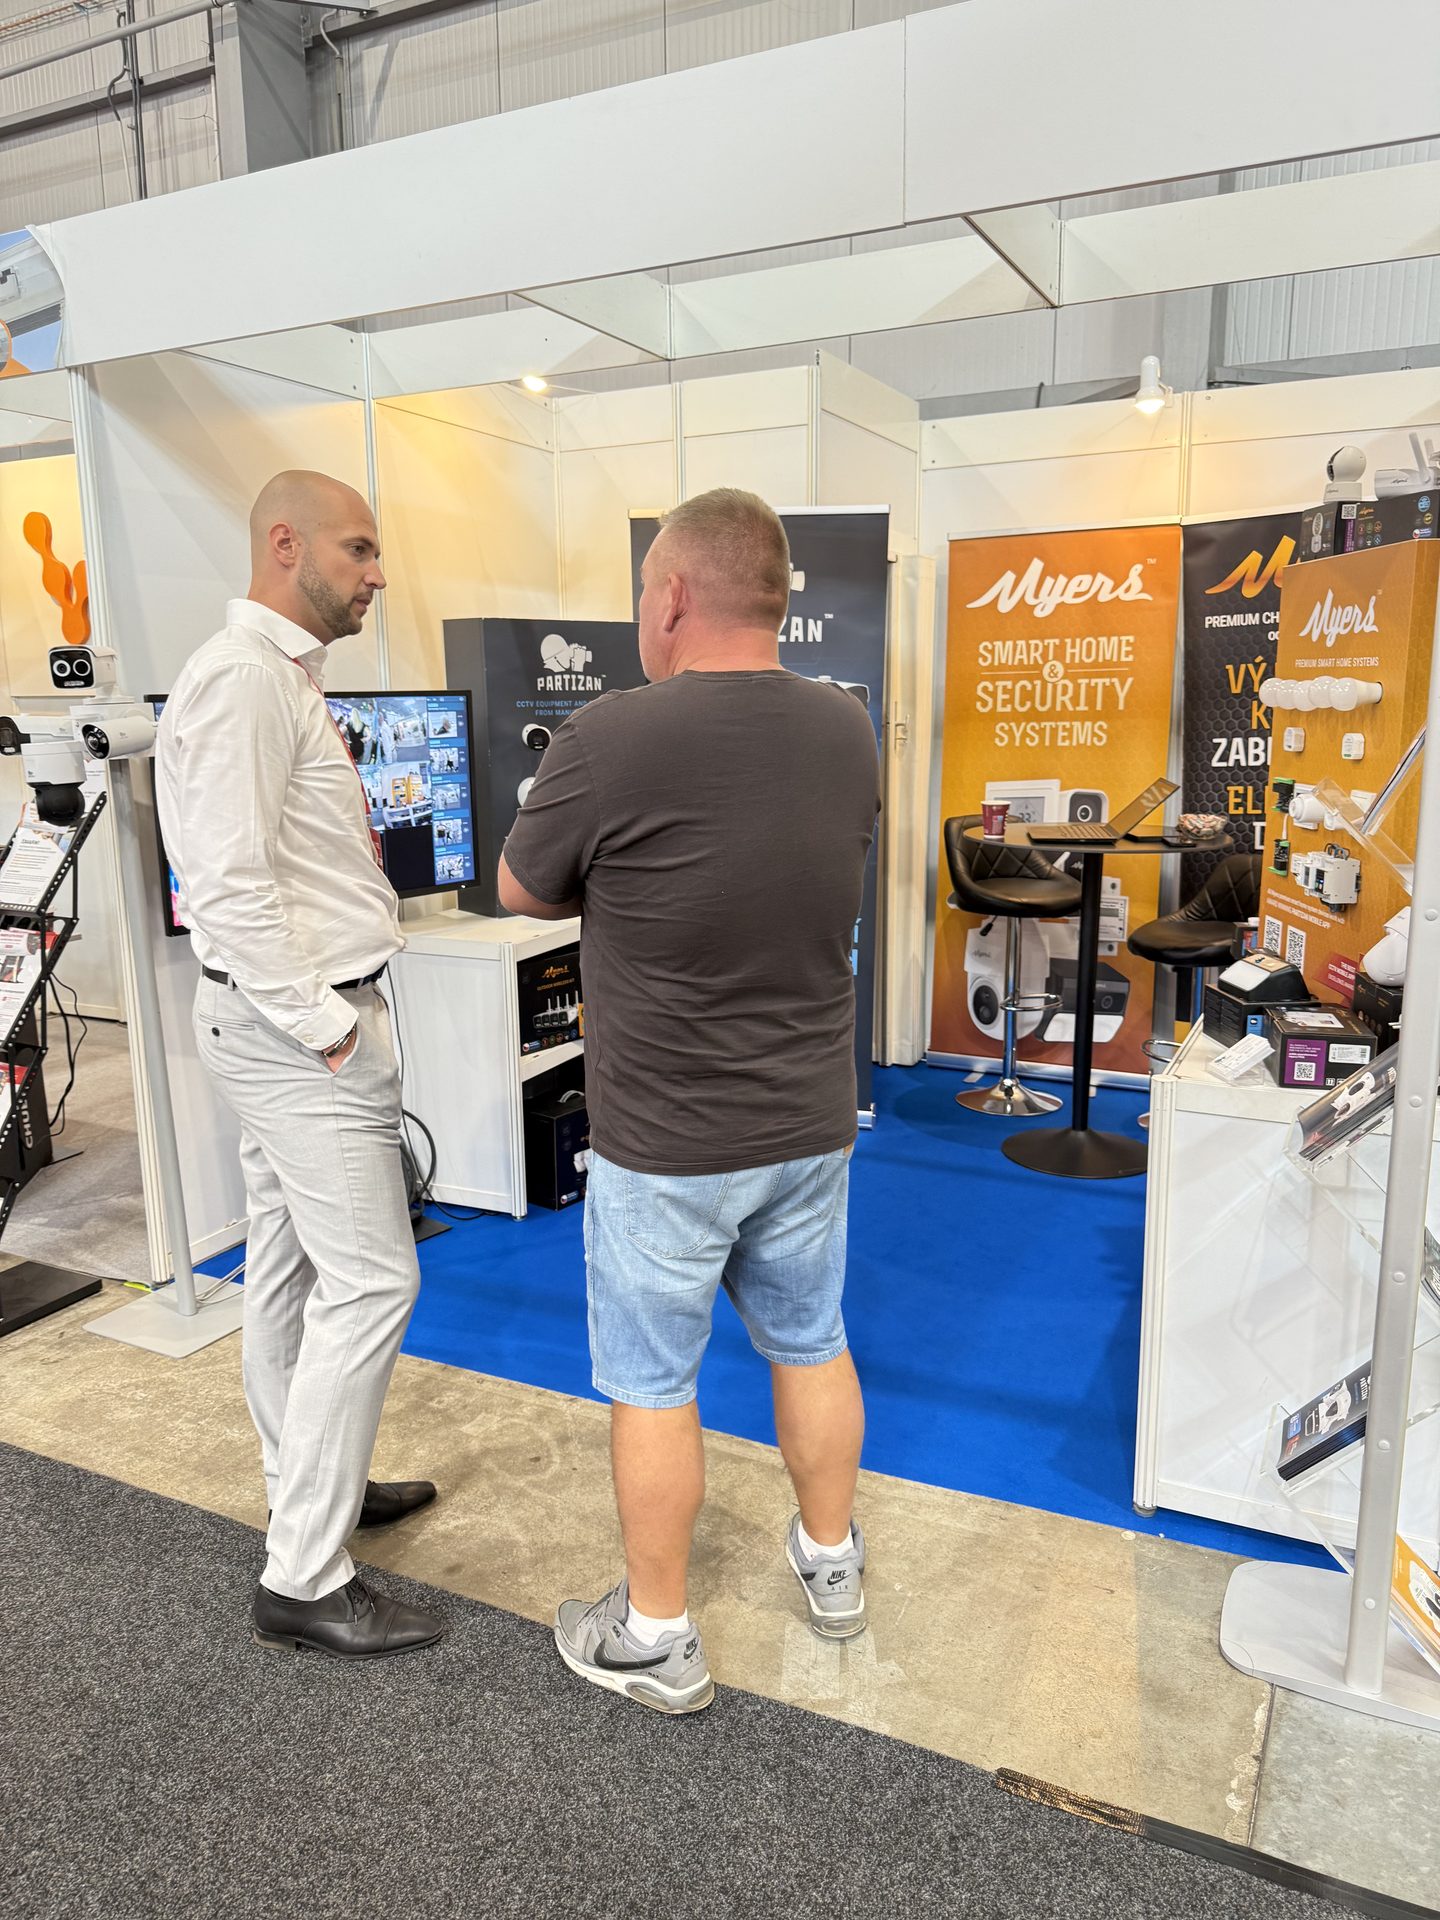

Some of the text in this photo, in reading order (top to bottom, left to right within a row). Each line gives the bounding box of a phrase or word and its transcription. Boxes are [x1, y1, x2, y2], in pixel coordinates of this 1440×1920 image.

[966, 557, 1153, 618] Myers
[1204, 613, 1260, 628] PREMIUM
[1299, 588, 1379, 648] Myers
[978, 635, 1135, 667] SMART HOME
[1295, 656, 1379, 668] PREMIUM SMART HOME SYSTEMS
[536, 674, 602, 692] PARTIZAN
[1225, 655, 1268, 695] VÝ
[516, 700, 534, 708] CCTV
[536, 700, 573, 708] EQUIPMENT
[975, 677, 1135, 713] SECURITY
[994, 720, 1109, 748] SYSTEMS
[830, 1569, 847, 1580] NIKE
